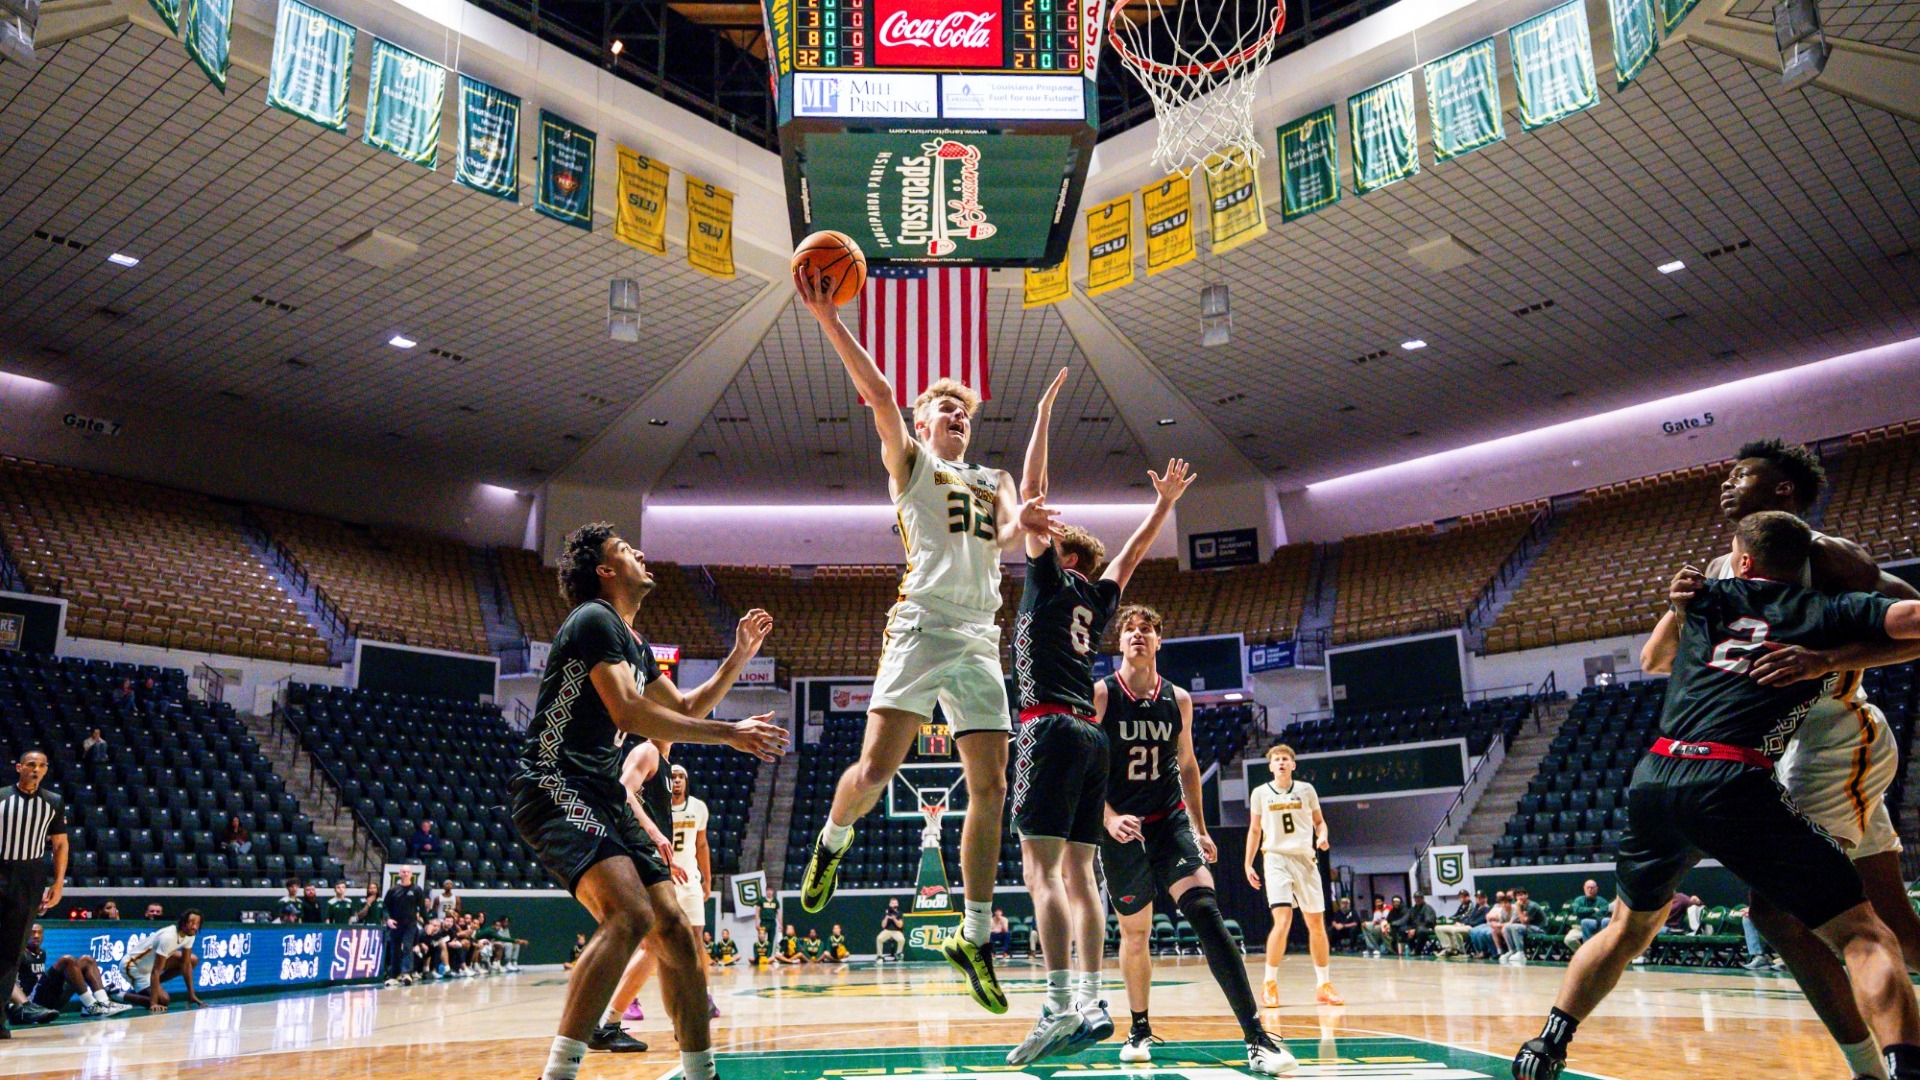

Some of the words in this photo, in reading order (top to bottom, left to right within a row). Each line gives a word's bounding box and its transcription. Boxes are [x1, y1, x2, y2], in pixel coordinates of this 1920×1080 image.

[809, 12, 819, 27] 3
[826, 12, 835, 27] 0
[853, 12, 862, 27] 0
[879, 10, 996, 48] Coca-Cola
[1024, 14, 1034, 30] 6
[1068, 16, 1077, 30] 0
[809, 31, 819, 46] 8
[826, 31, 835, 46] 0
[853, 32, 862, 46] 0
[1025, 34, 1035, 48] 7
[1068, 35, 1078, 50] 4
[798, 50, 819, 66] 32
[826, 50, 835, 66] 0
[854, 52, 862, 66] 3
[1014, 54, 1035, 68] 21
[1042, 54, 1051, 68] 0
[1068, 54, 1078, 69] 0
[850, 97, 929, 113] PRINTING
[868, 152, 893, 188] PARISH
[896, 156, 931, 244] Crossroads
[1215, 184, 1250, 210] SLU
[866, 192, 893, 248] TANGIPAHOA
[1150, 214, 1186, 234] SLU
[1092, 237, 1125, 254] SLU
[63, 414, 104, 432] Gate
[111, 422, 120, 435] 7
[1663, 418, 1699, 433] Gate
[1704, 412, 1714, 424] 5
[1070, 605, 1093, 658] 6
[1706, 616, 1770, 674] 2
[738, 673, 769, 682] LION!
[1118, 720, 1172, 741] UIW
[929, 737, 946, 750] 17
[1128, 745, 1161, 781] 21
[1442, 860, 1457, 878] S
[744, 884, 758, 900] S
[202, 934, 227, 960] The
[229, 932, 251, 958] Old
[282, 934, 303, 956] The
[304, 932, 322, 956] Old
[199, 960, 247, 986] School
[280, 956, 318, 980] School
